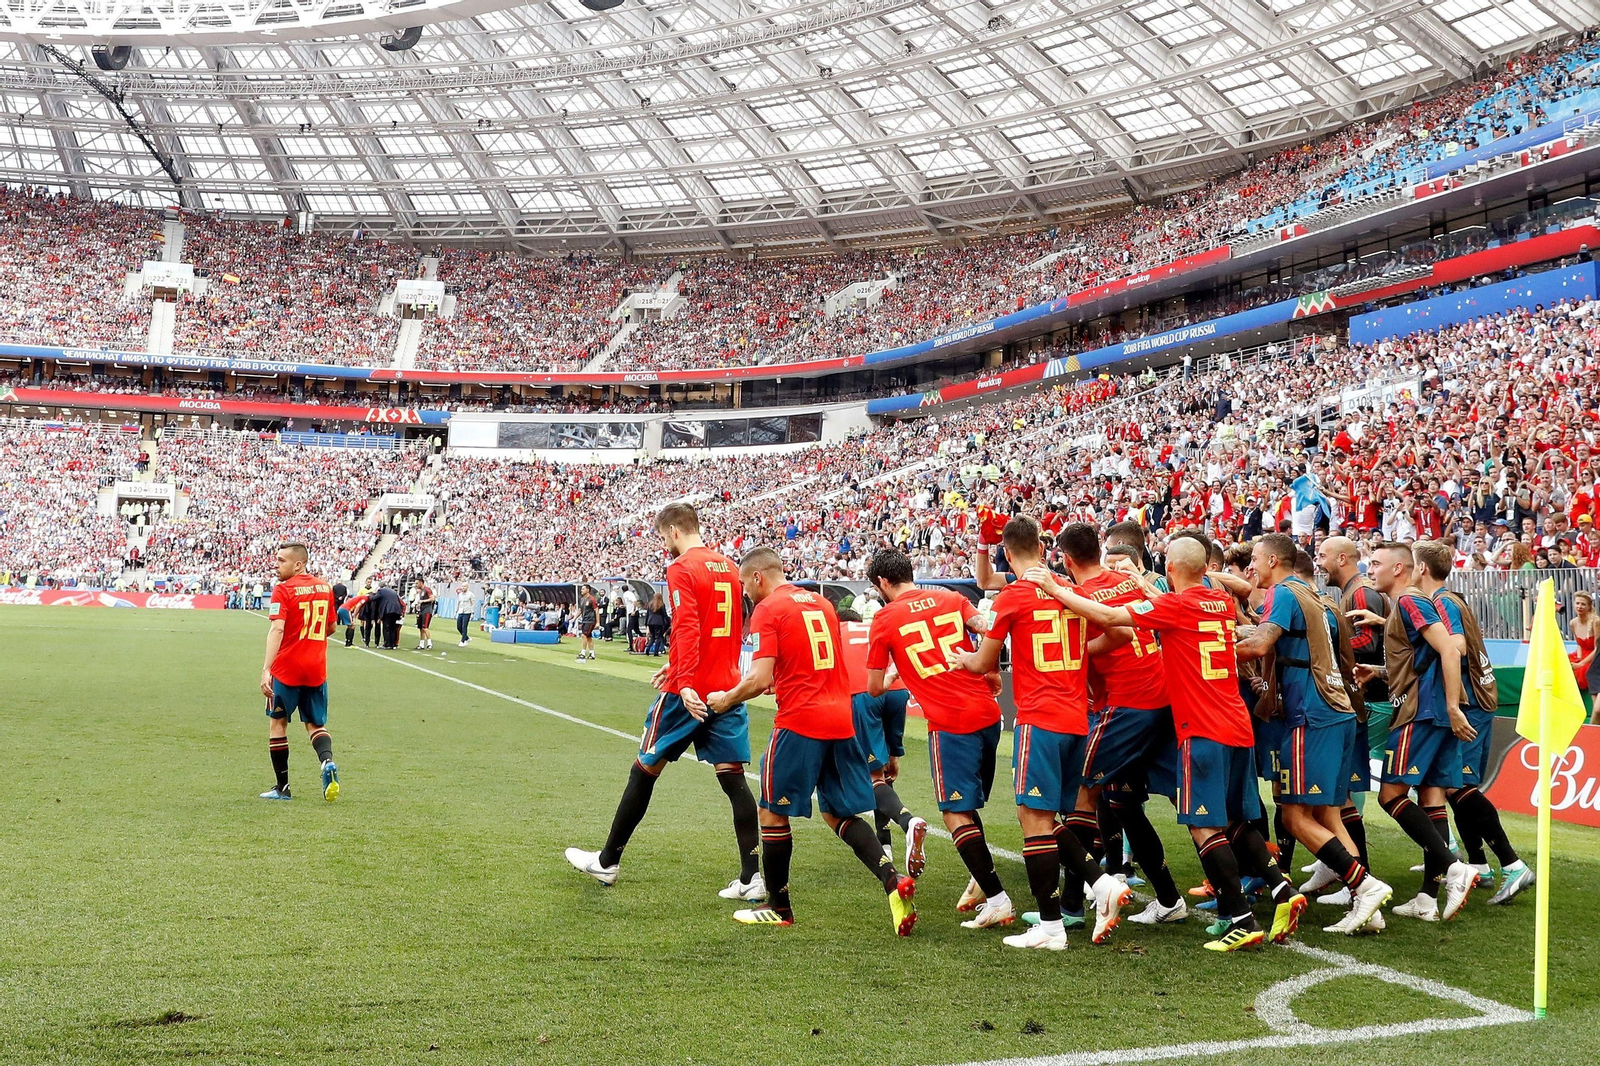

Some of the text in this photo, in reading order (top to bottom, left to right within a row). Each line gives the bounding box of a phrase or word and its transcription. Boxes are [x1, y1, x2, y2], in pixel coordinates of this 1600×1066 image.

[1123, 324, 1216, 354] 2018 FIFA WORLD CUP RUSSIA
[62, 350, 298, 372] ЧЕМПИОНАТ МИРА ПО ФУТБОЛУ FIFA 2018 В РОССИИ
[624, 373, 659, 382] МОСКВА
[977, 378, 1002, 389] #worldcup
[179, 400, 221, 410] МОСКВА
[711, 581, 733, 638] 3
[907, 597, 937, 614] ISCO
[1199, 600, 1228, 613] SILVA
[298, 600, 329, 641] 18
[801, 610, 835, 671] 8
[898, 610, 964, 680] 22
[1032, 609, 1087, 673] 20
